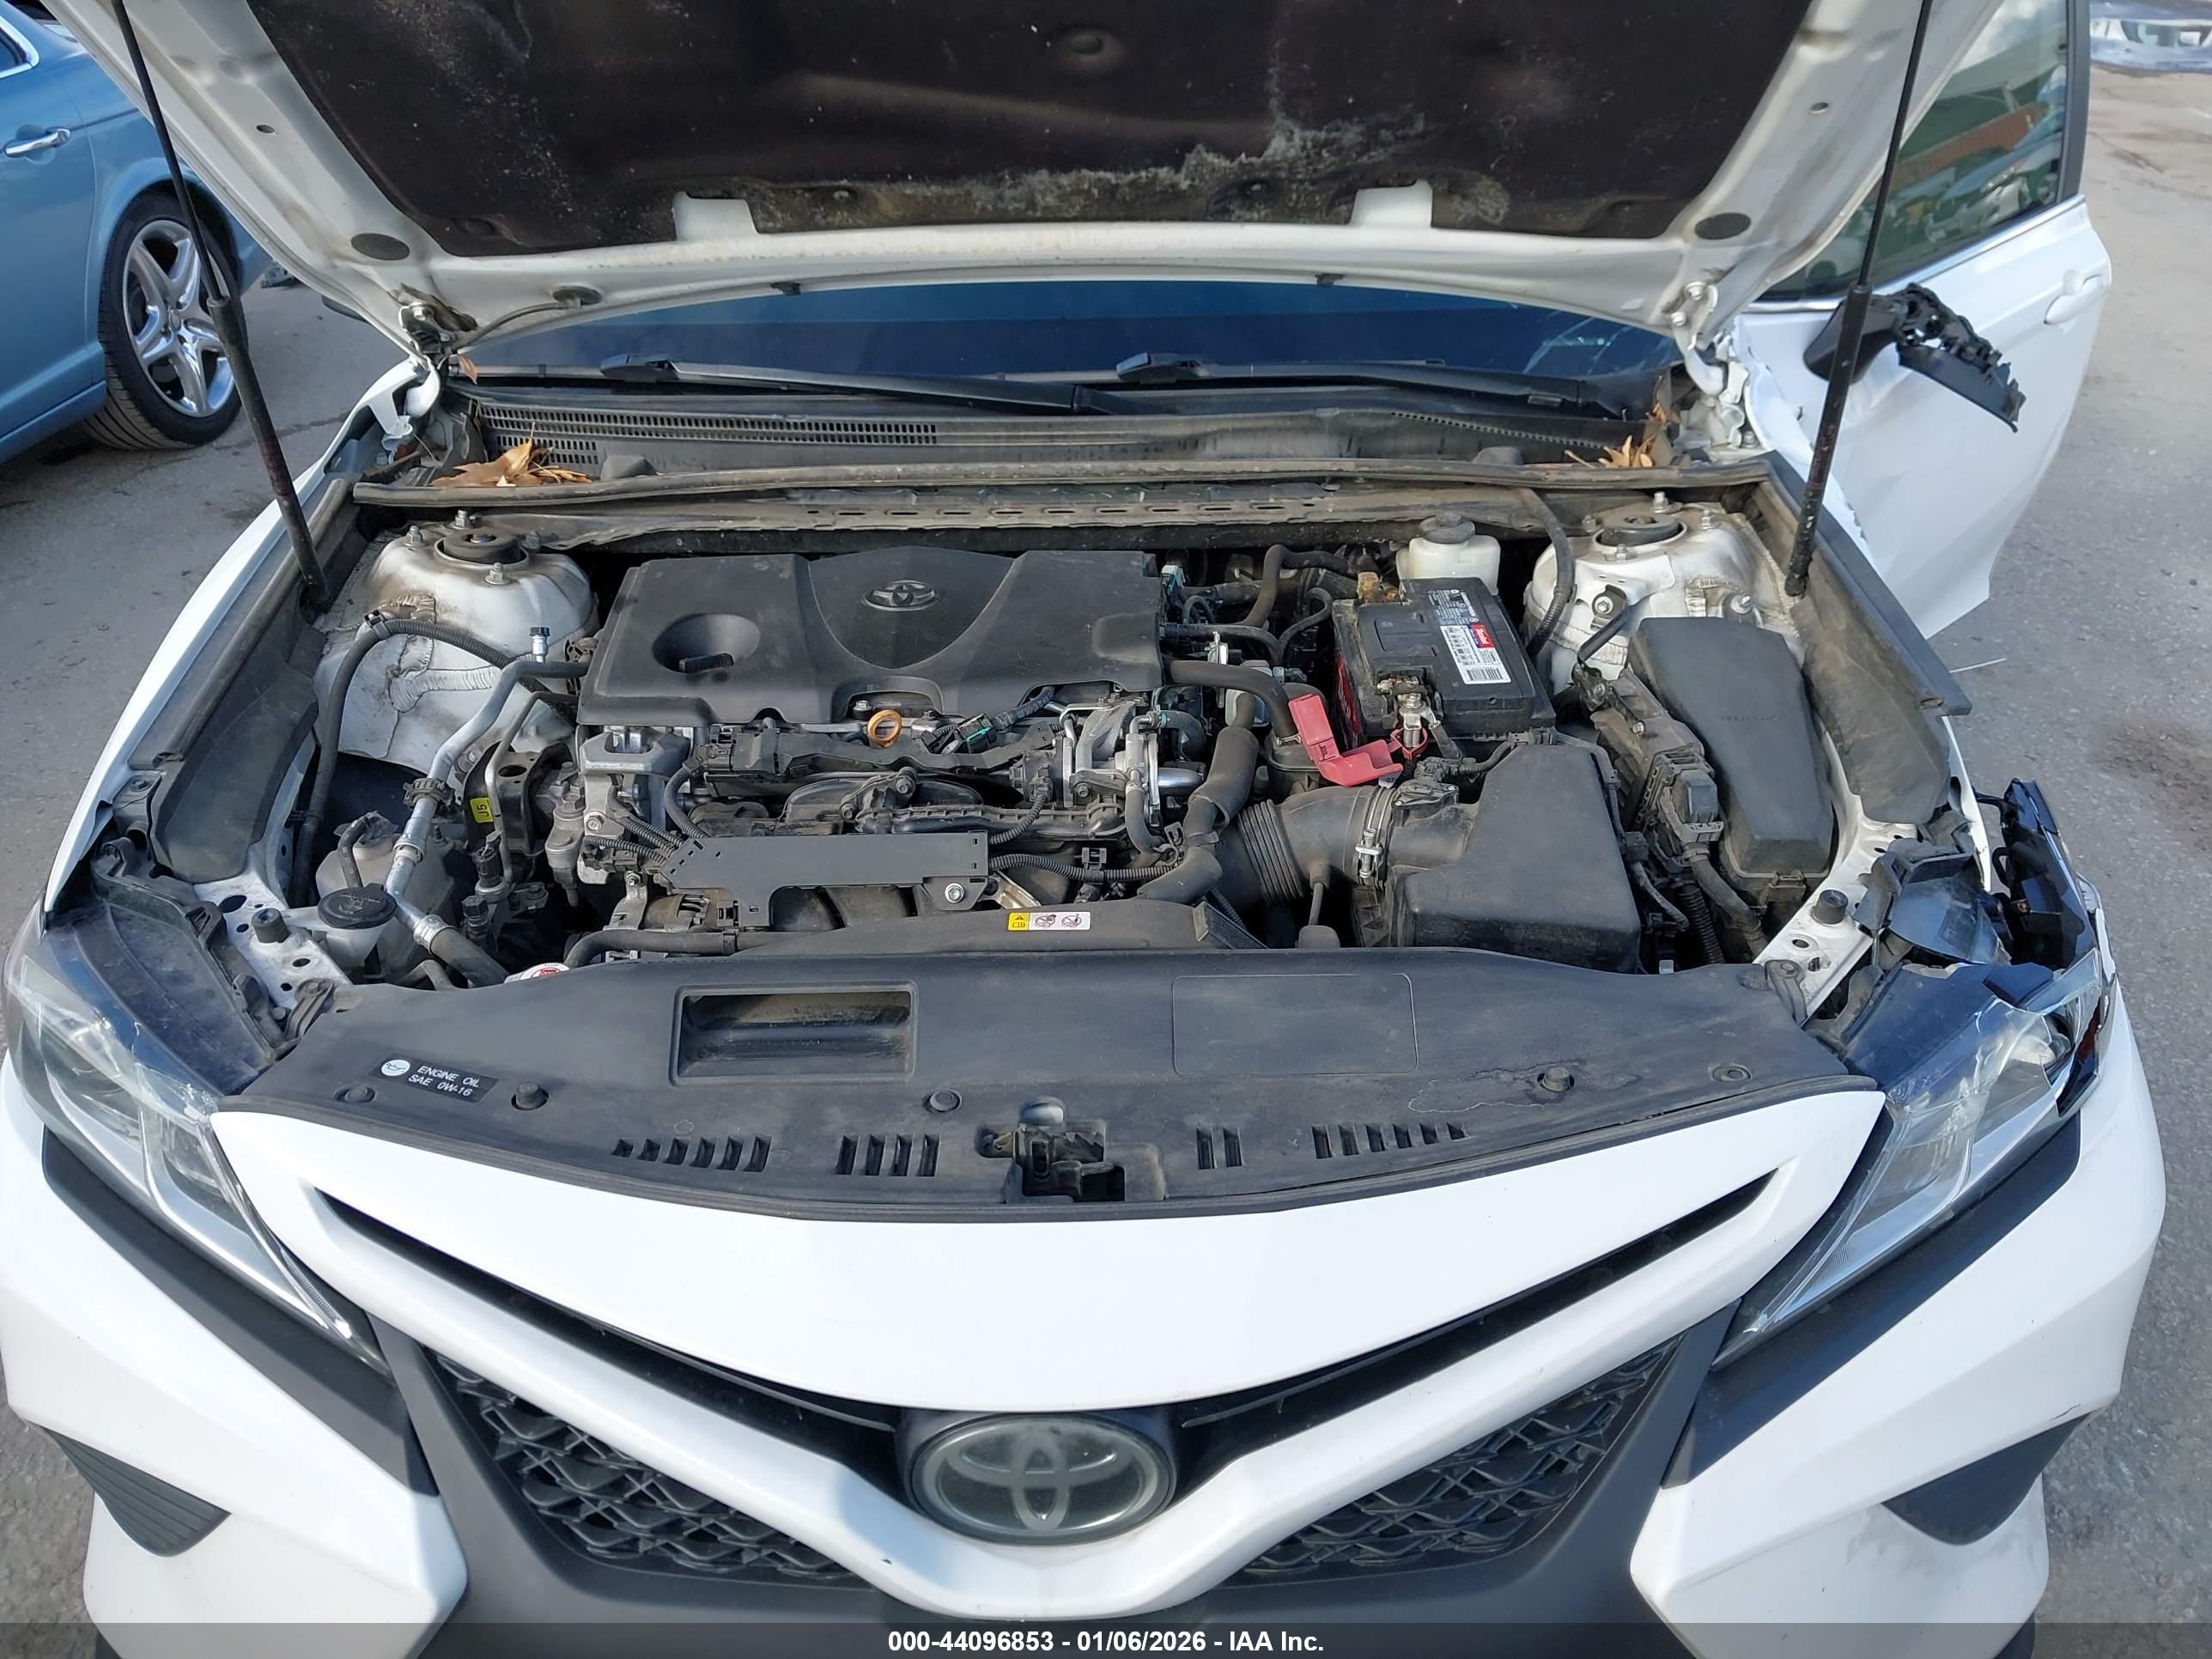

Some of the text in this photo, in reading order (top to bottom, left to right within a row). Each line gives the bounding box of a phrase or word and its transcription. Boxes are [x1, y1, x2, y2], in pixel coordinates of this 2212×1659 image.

[477, 805, 489, 817] J5
[408, 1074, 472, 1096] SAE 0W-16
[417, 1066, 480, 1087] ENGINE OIL
